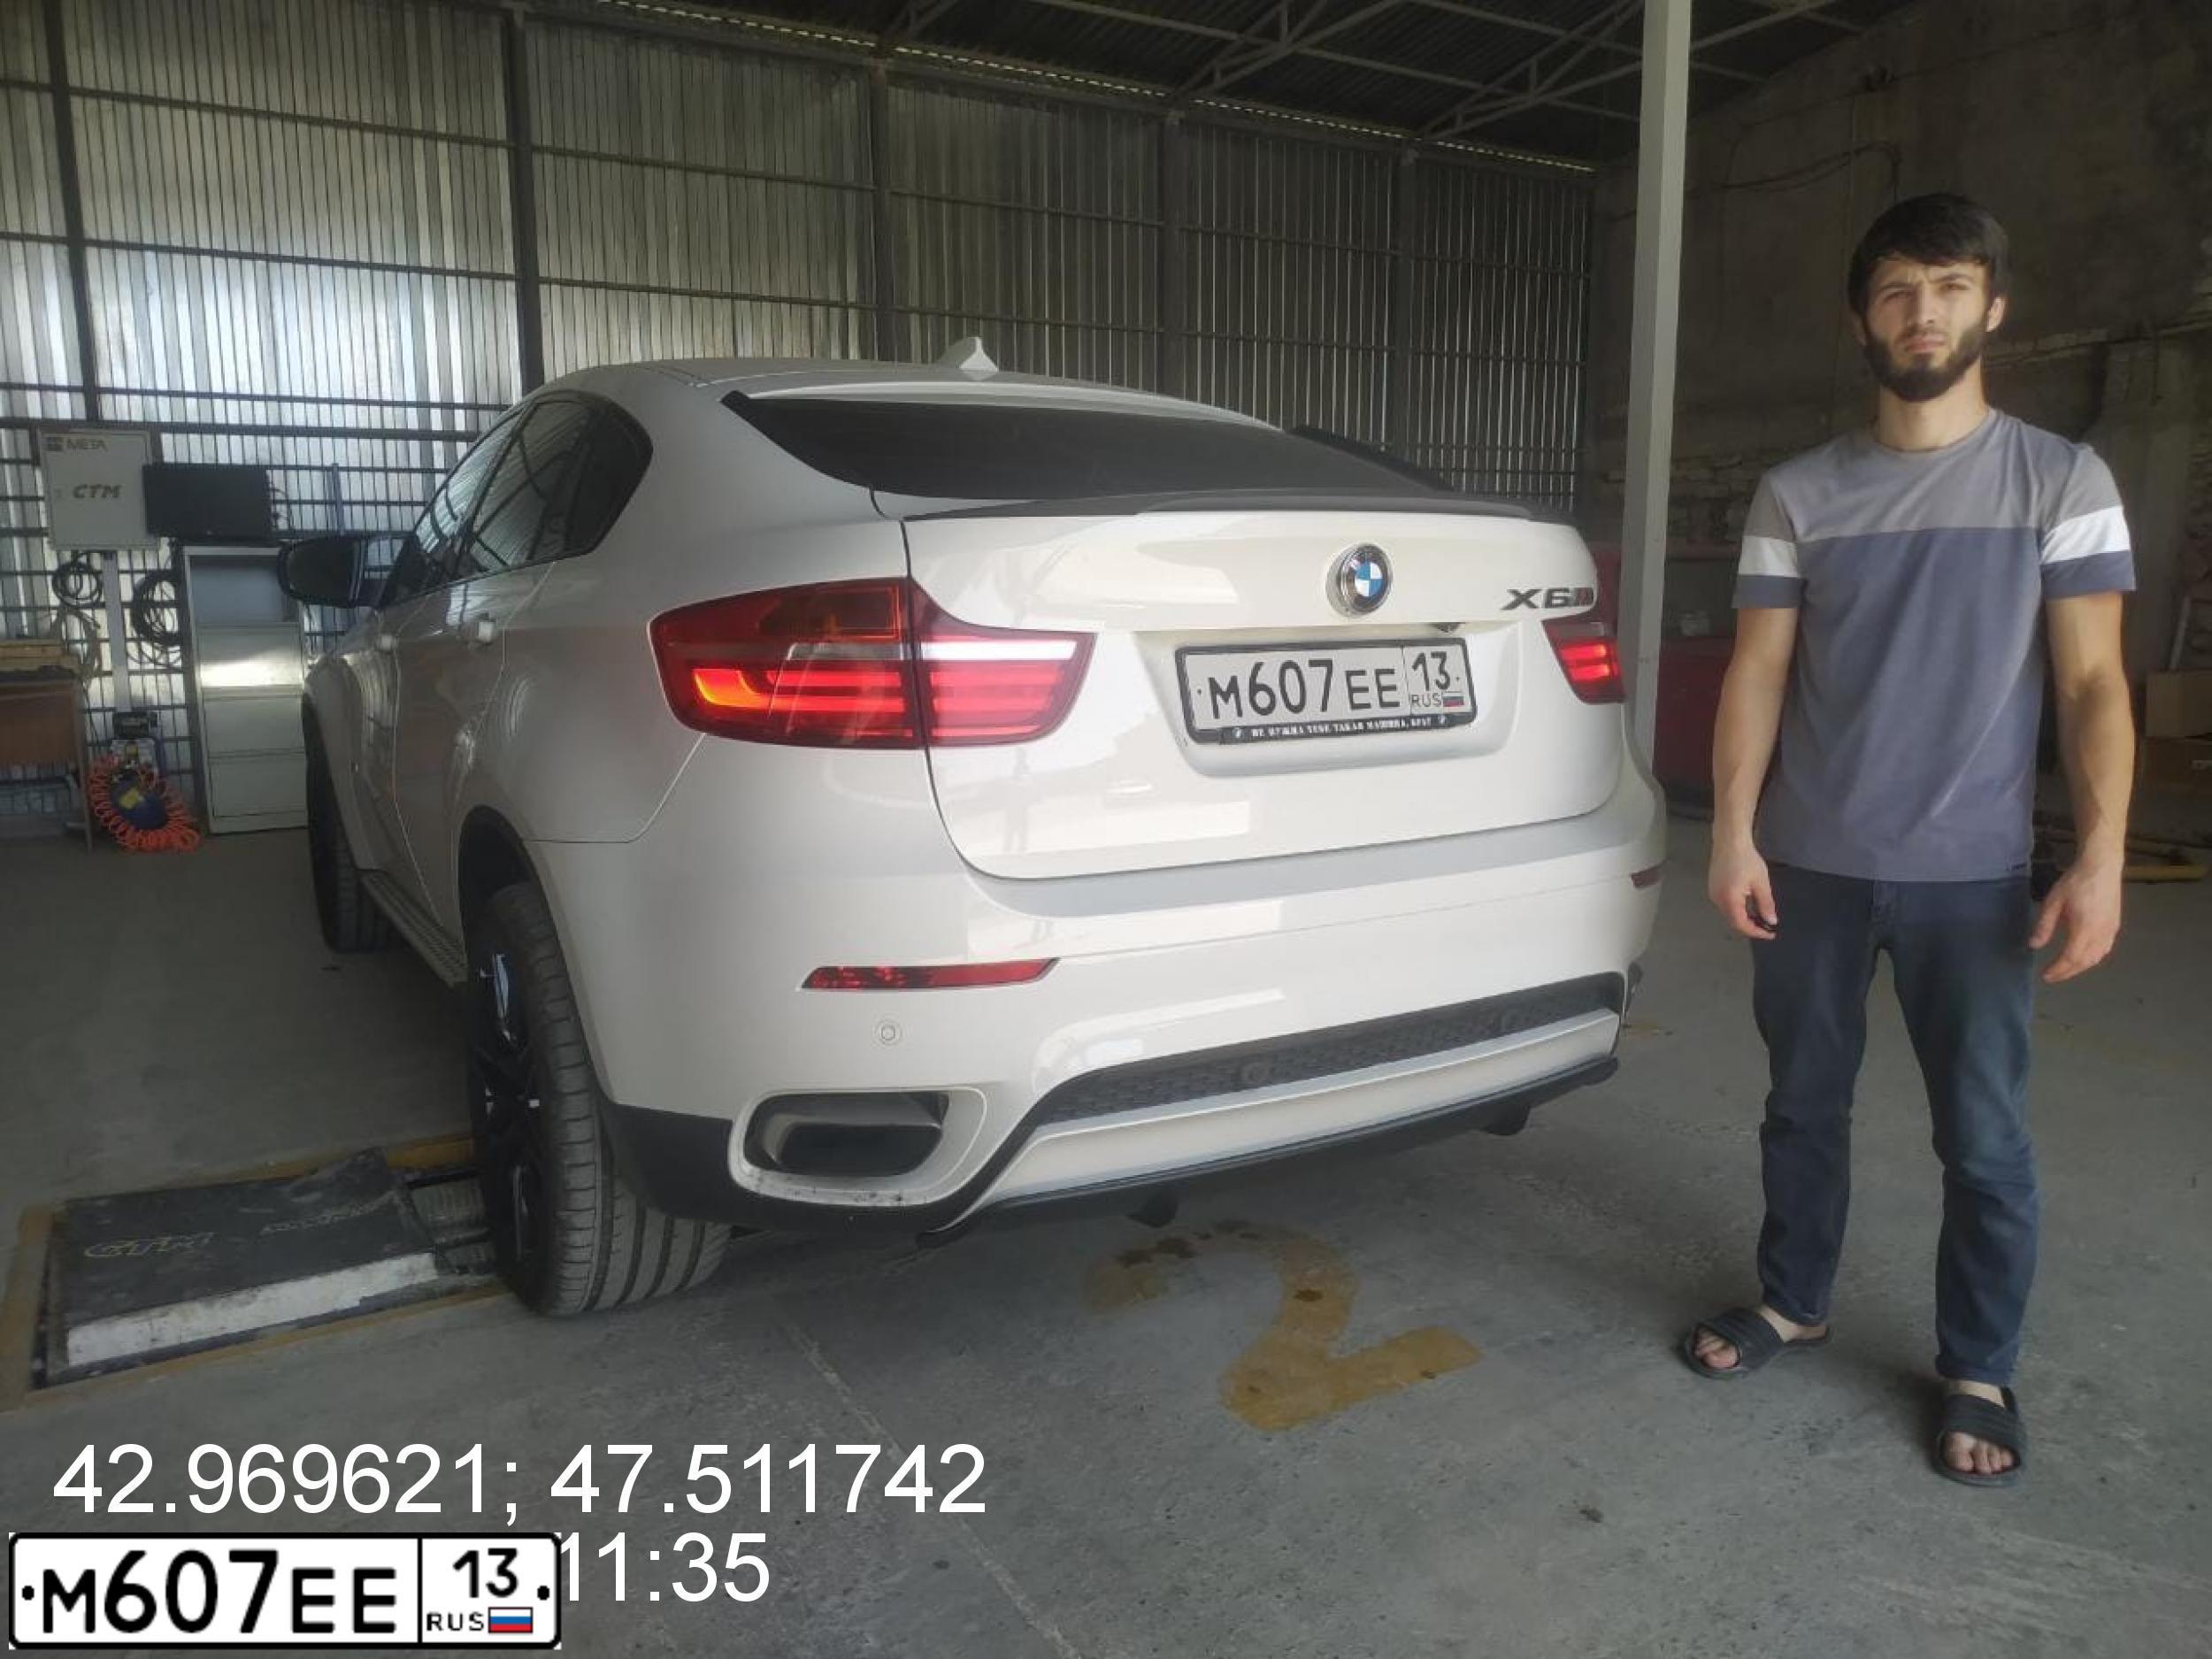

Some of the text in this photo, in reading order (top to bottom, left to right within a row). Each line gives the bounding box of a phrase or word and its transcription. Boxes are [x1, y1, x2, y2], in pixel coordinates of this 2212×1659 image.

[1208, 658, 1401, 719] М607ЕЕ
[1411, 650, 1451, 692] 13
[1409, 691, 1441, 707] RUS
